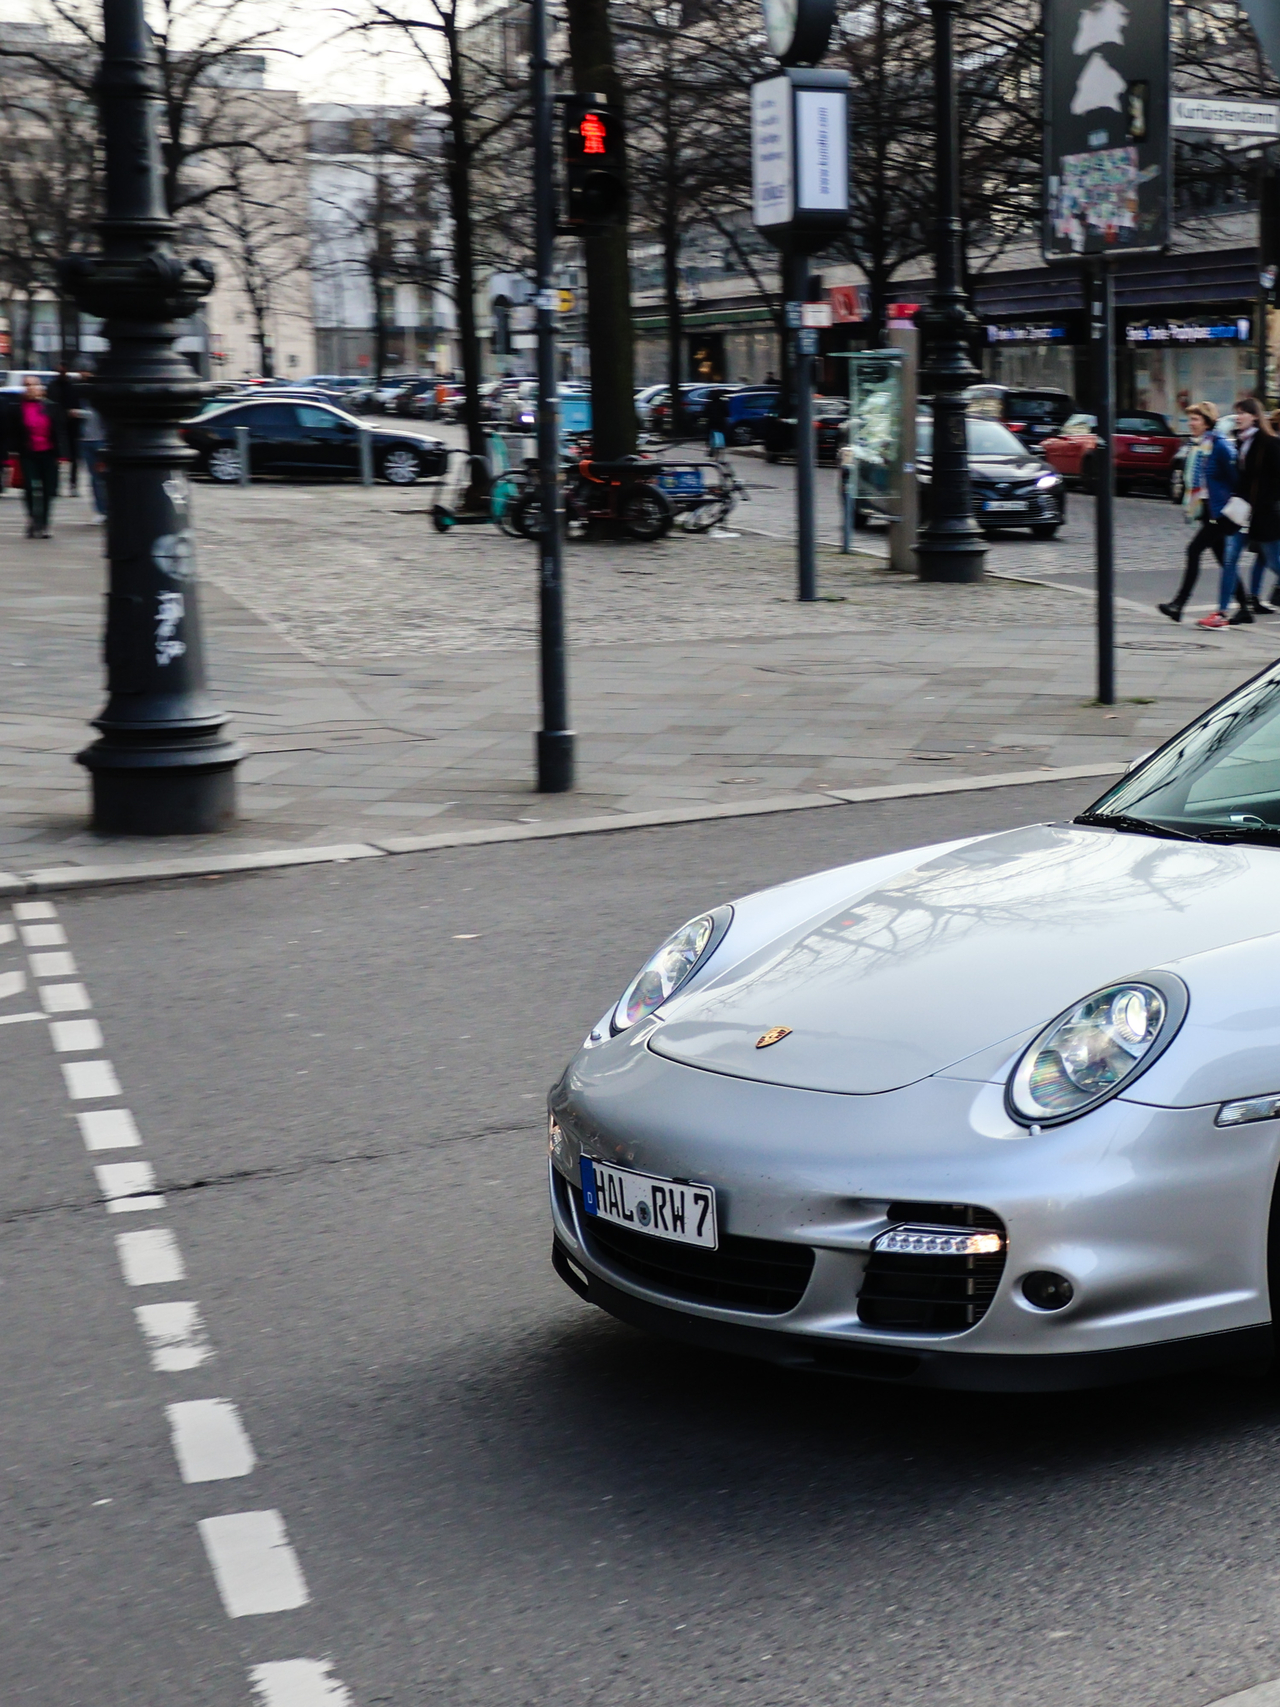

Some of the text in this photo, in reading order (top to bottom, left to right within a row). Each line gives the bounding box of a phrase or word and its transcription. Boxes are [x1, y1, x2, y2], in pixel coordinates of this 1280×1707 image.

[593, 1168, 710, 1237] HAL RW 7
